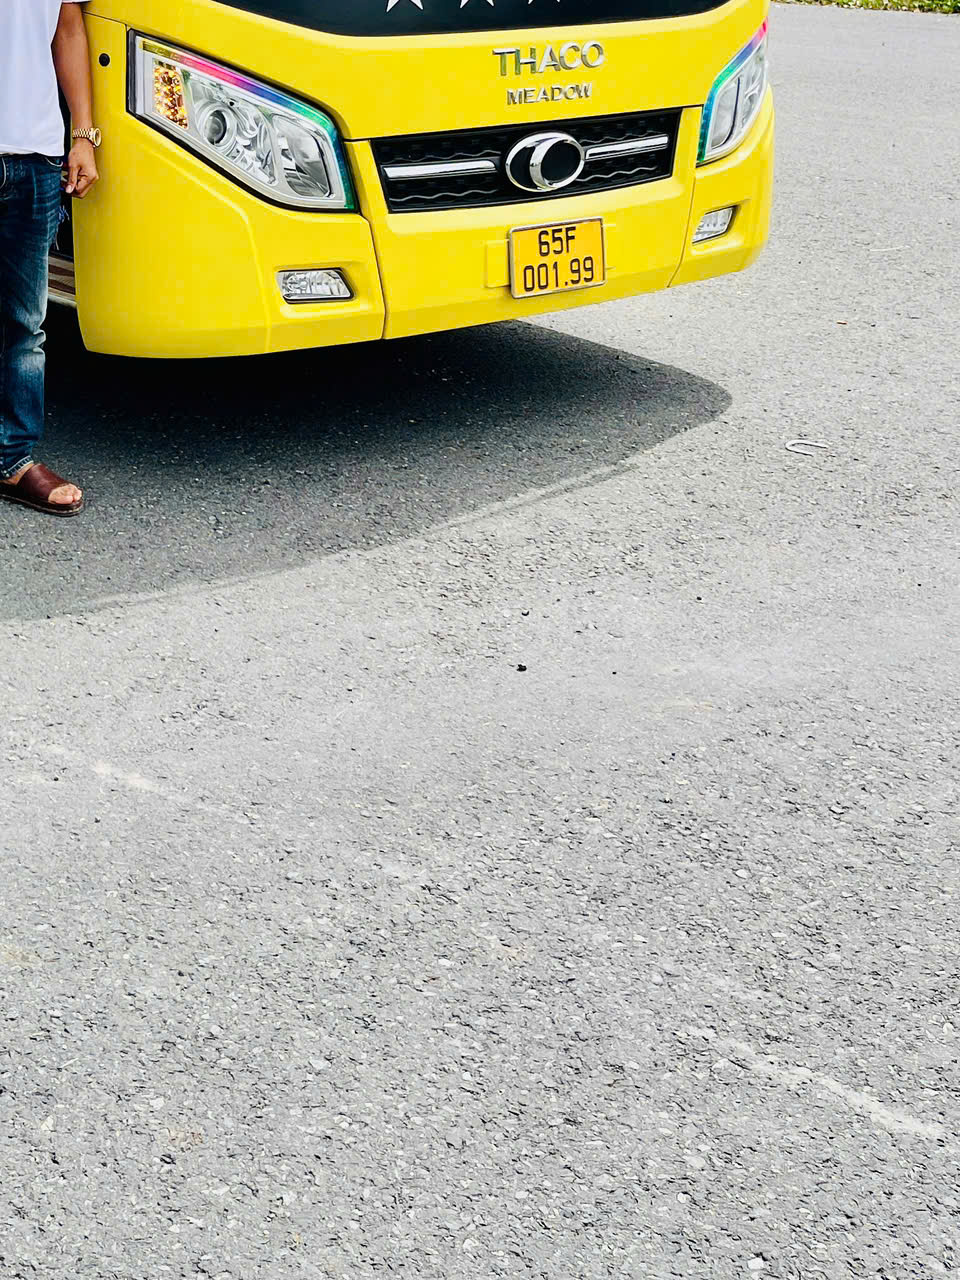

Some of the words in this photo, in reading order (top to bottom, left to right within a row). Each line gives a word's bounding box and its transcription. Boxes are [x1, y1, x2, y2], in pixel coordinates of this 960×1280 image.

[492, 39, 605, 77] THACO
[506, 82, 592, 106] MEADOW
[537, 225, 577, 257] 65F
[522, 256, 595, 293] 001.99
